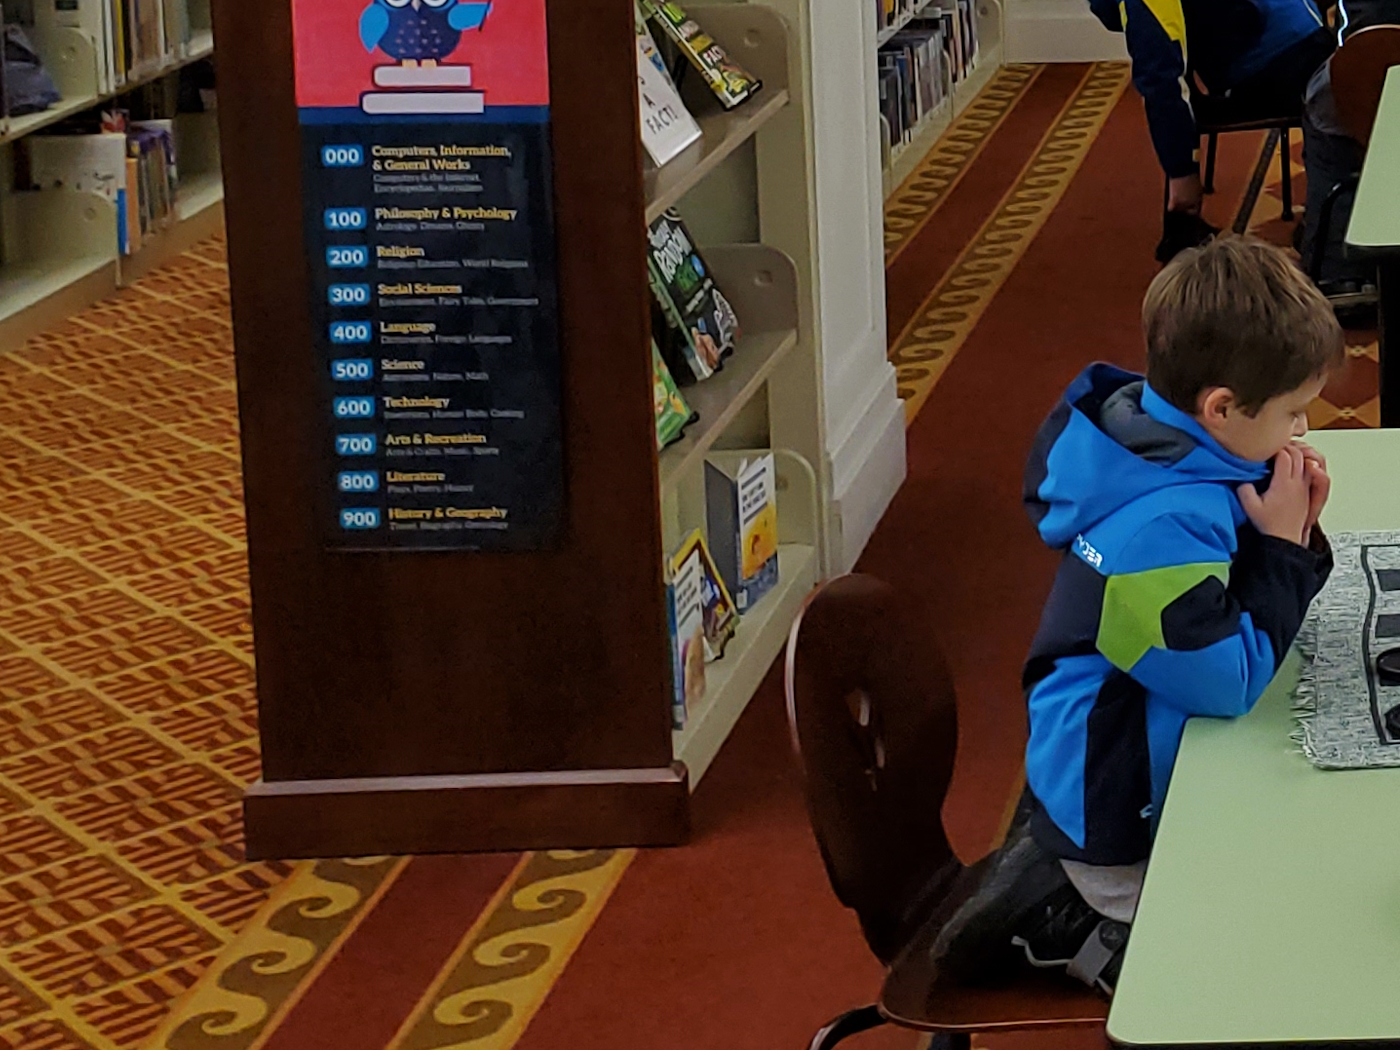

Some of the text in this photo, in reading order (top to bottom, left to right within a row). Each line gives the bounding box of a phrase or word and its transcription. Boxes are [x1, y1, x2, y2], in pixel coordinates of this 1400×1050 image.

[646, 104, 678, 135] FACT!
[325, 148, 359, 164] 000
[372, 159, 471, 171] & General Works
[329, 212, 361, 227] 100
[375, 207, 517, 220] Philosophy & Psychology
[330, 250, 364, 265] 200
[376, 246, 425, 258] Religion
[332, 288, 365, 303] 300
[378, 284, 412, 295] Social
[334, 325, 367, 340] 400
[336, 363, 368, 378] 500
[381, 359, 425, 370] Science
[337, 400, 371, 415] 600
[384, 396, 449, 409] Technology
[339, 438, 372, 452] 700
[385, 433, 486, 444] Arts & Recreation
[341, 475, 374, 489] 800
[343, 512, 376, 527] 900
[388, 507, 508, 520] History & Geography
